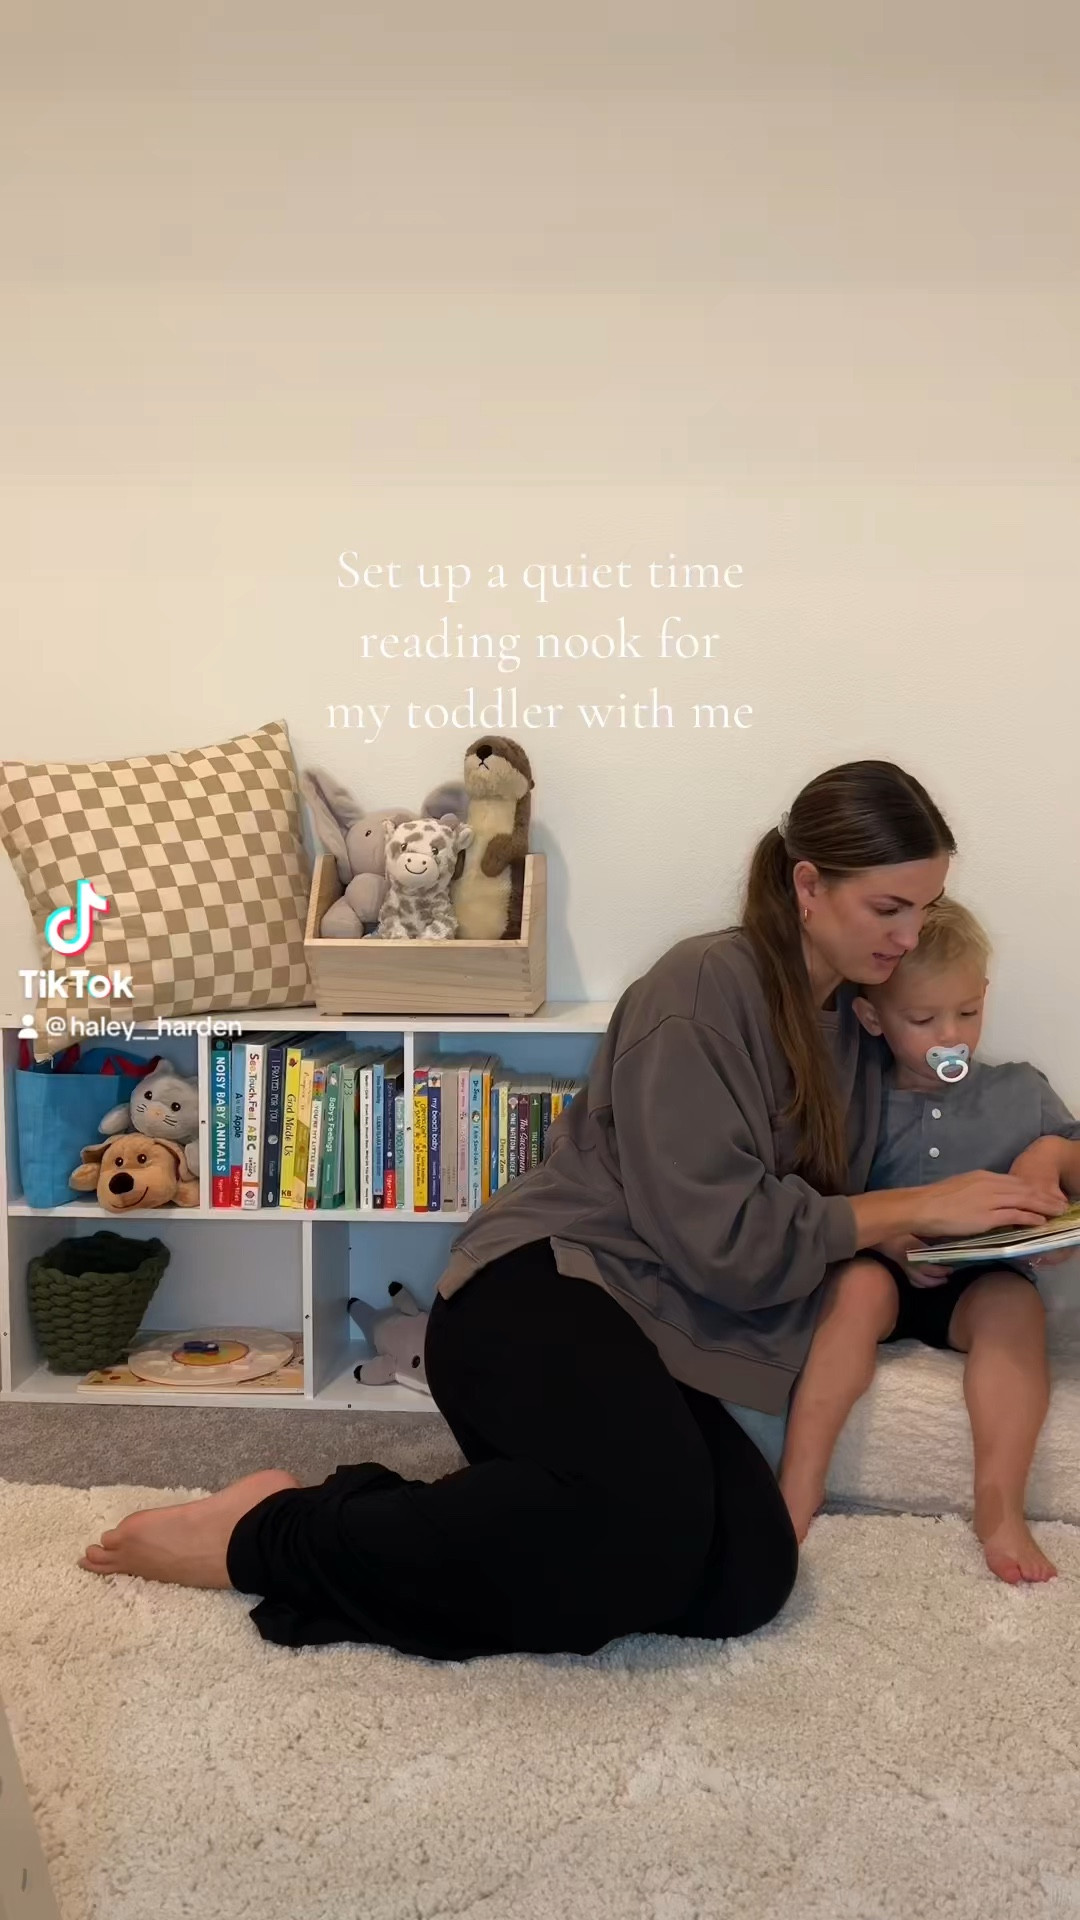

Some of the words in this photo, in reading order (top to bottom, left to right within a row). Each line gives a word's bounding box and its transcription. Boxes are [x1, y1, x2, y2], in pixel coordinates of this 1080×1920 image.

[216, 1057, 226, 1088] NOISY
[216, 1092, 226, 1121] BABY
[270, 1094, 278, 1107] FOR
[286, 1094, 295, 1113] God
[327, 1097, 336, 1121] Baby's
[430, 1098, 438, 1108] my
[233, 1115, 243, 1138] Apple
[270, 1109, 278, 1122] YOU
[285, 1117, 295, 1141] Made
[326, 1123, 335, 1152] Feelings
[216, 1122, 226, 1171] ANIMALS
[284, 1145, 293, 1156] Us
[430, 1134, 438, 1151] baby
